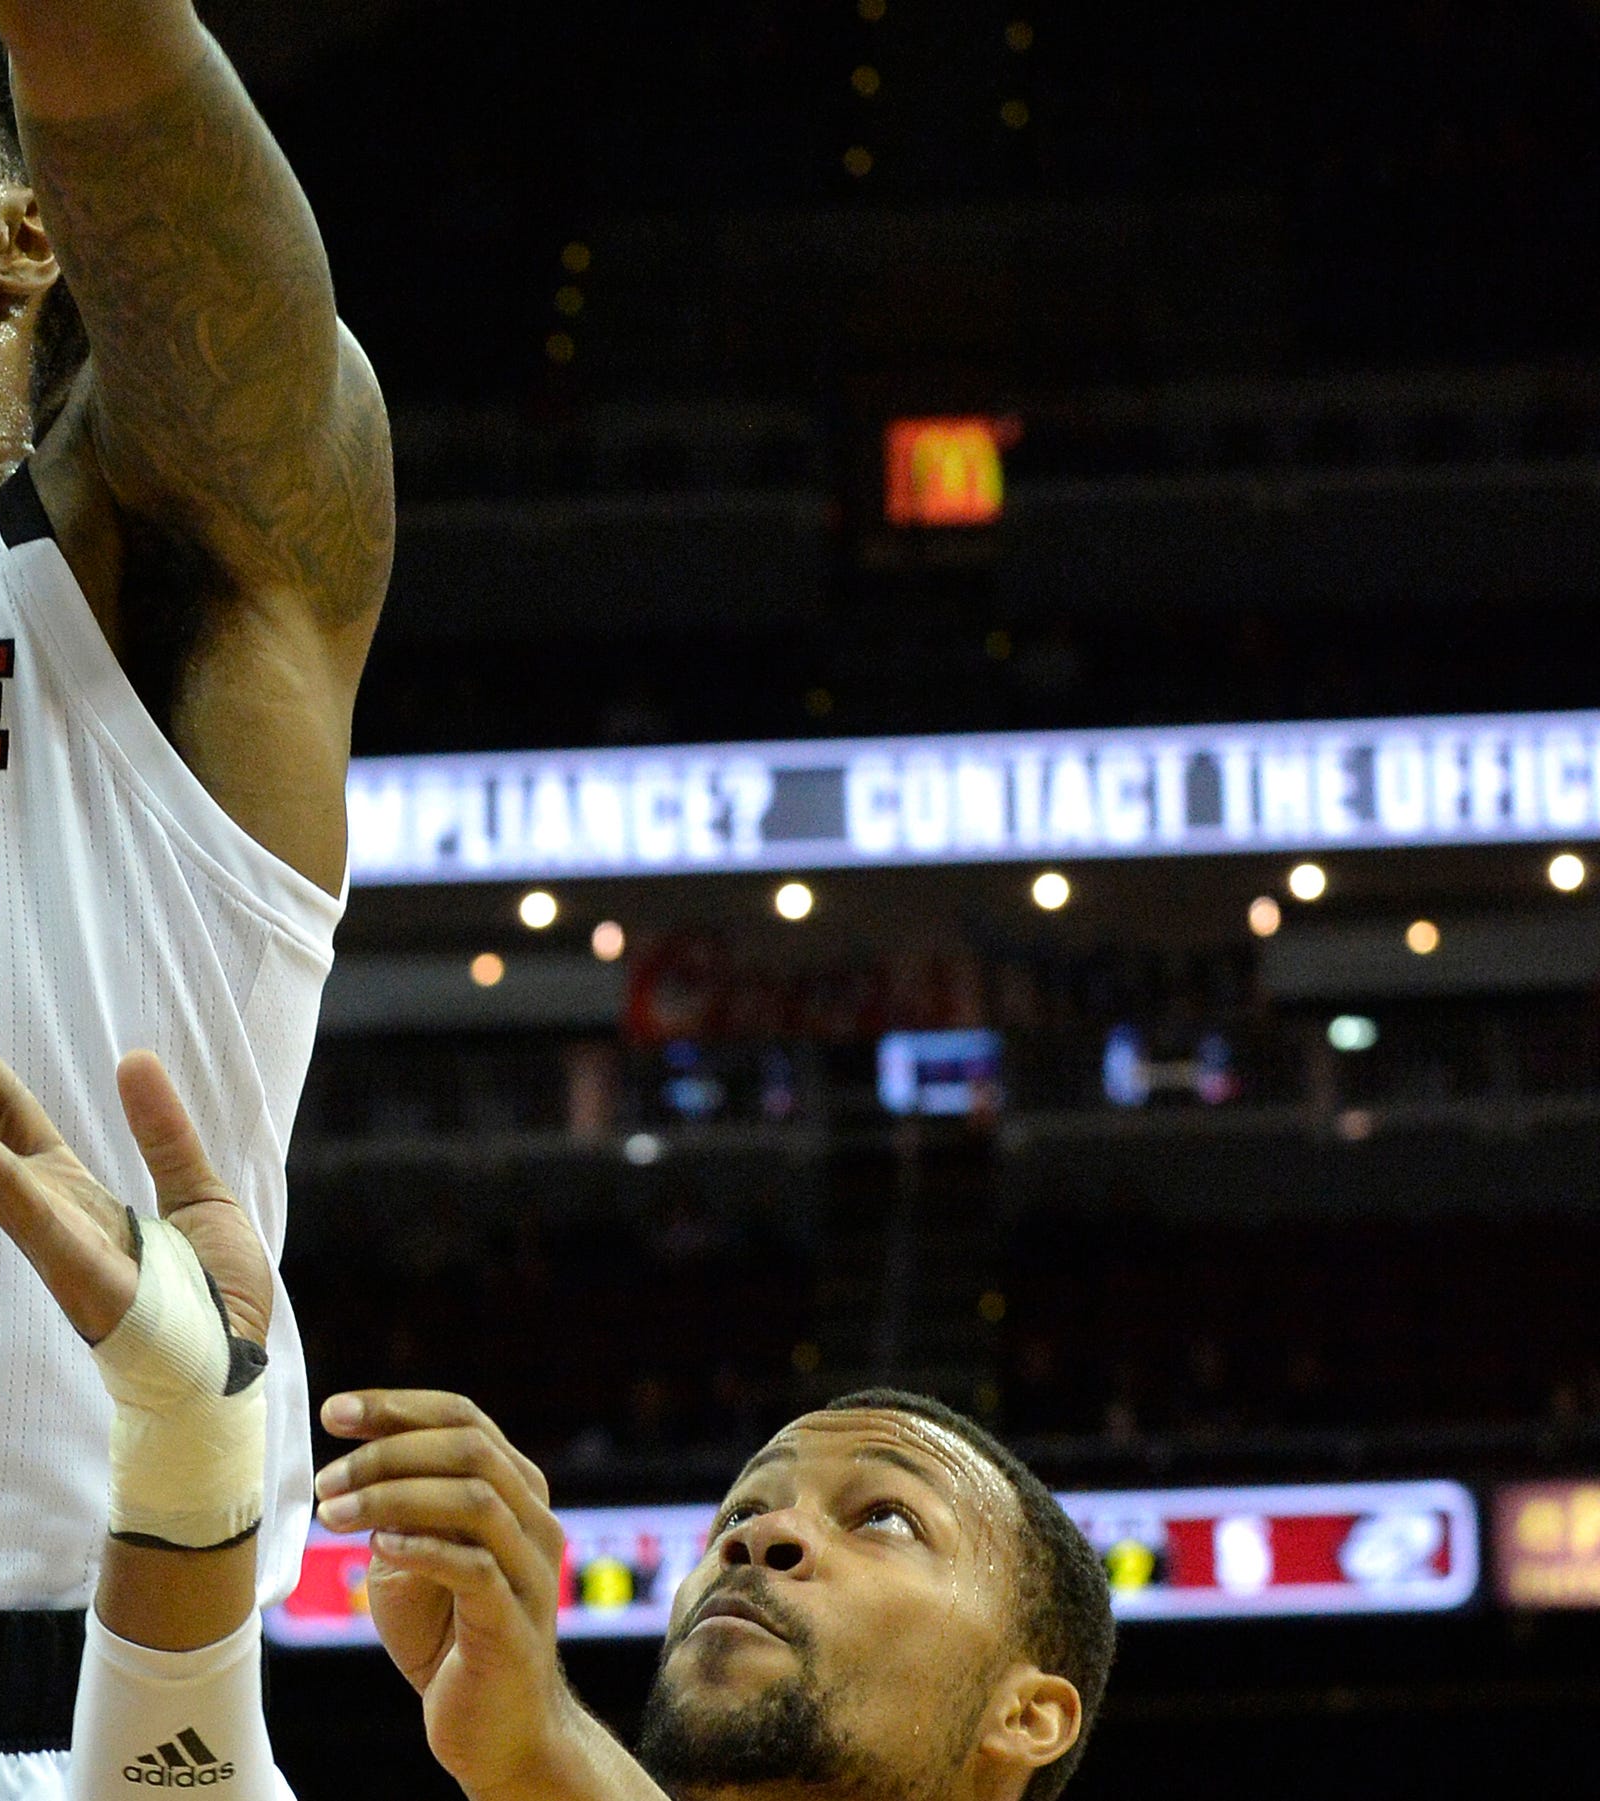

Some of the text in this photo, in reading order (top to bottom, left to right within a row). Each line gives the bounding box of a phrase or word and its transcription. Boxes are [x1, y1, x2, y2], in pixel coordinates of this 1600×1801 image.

[844, 738, 1188, 854] CONTACT
[1222, 736, 1356, 842] THE
[1376, 722, 1600, 838] OFFIC
[122, 1761, 236, 1788] adidas
